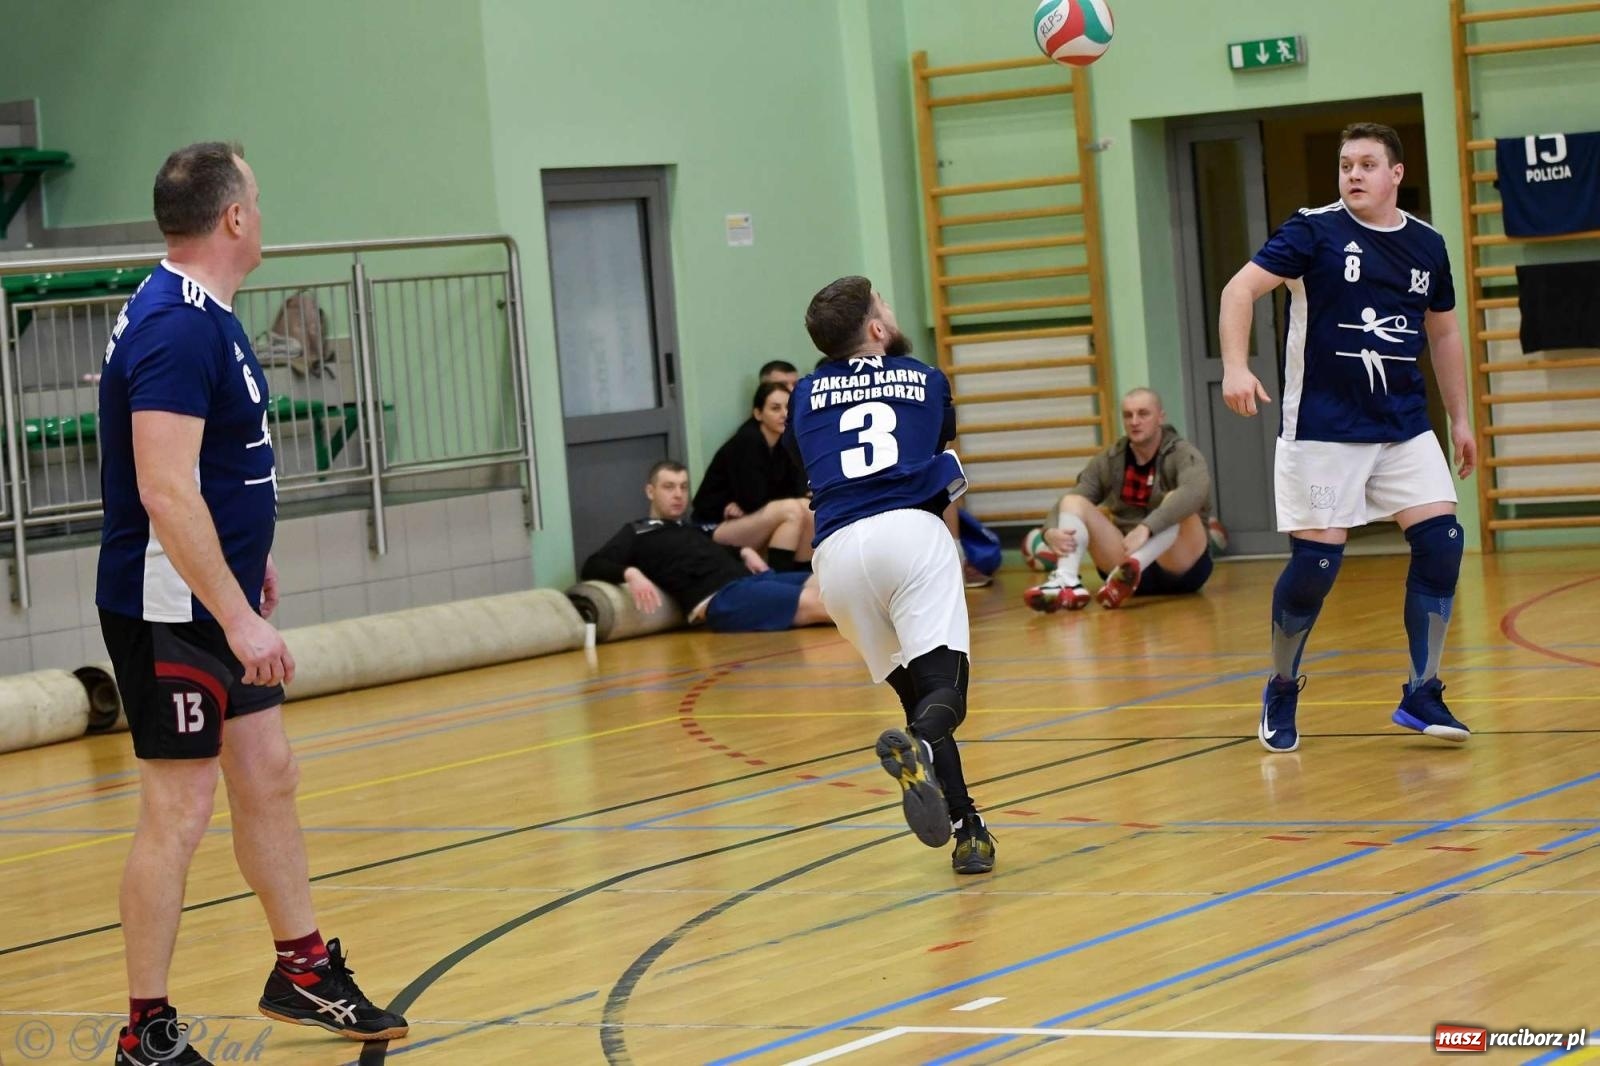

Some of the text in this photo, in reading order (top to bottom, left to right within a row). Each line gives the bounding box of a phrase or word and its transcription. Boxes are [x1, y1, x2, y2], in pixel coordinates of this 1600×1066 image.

[1040, 10, 1063, 37] RLPS
[1526, 165, 1572, 183] POLICJA
[1344, 255, 1361, 283] 8
[242, 364, 261, 404] 6
[811, 369, 927, 394] ZAKŁAD KARNY
[810, 384, 926, 411] W RACIBORZU
[839, 401, 899, 479] 3
[172, 692, 205, 733] 13
